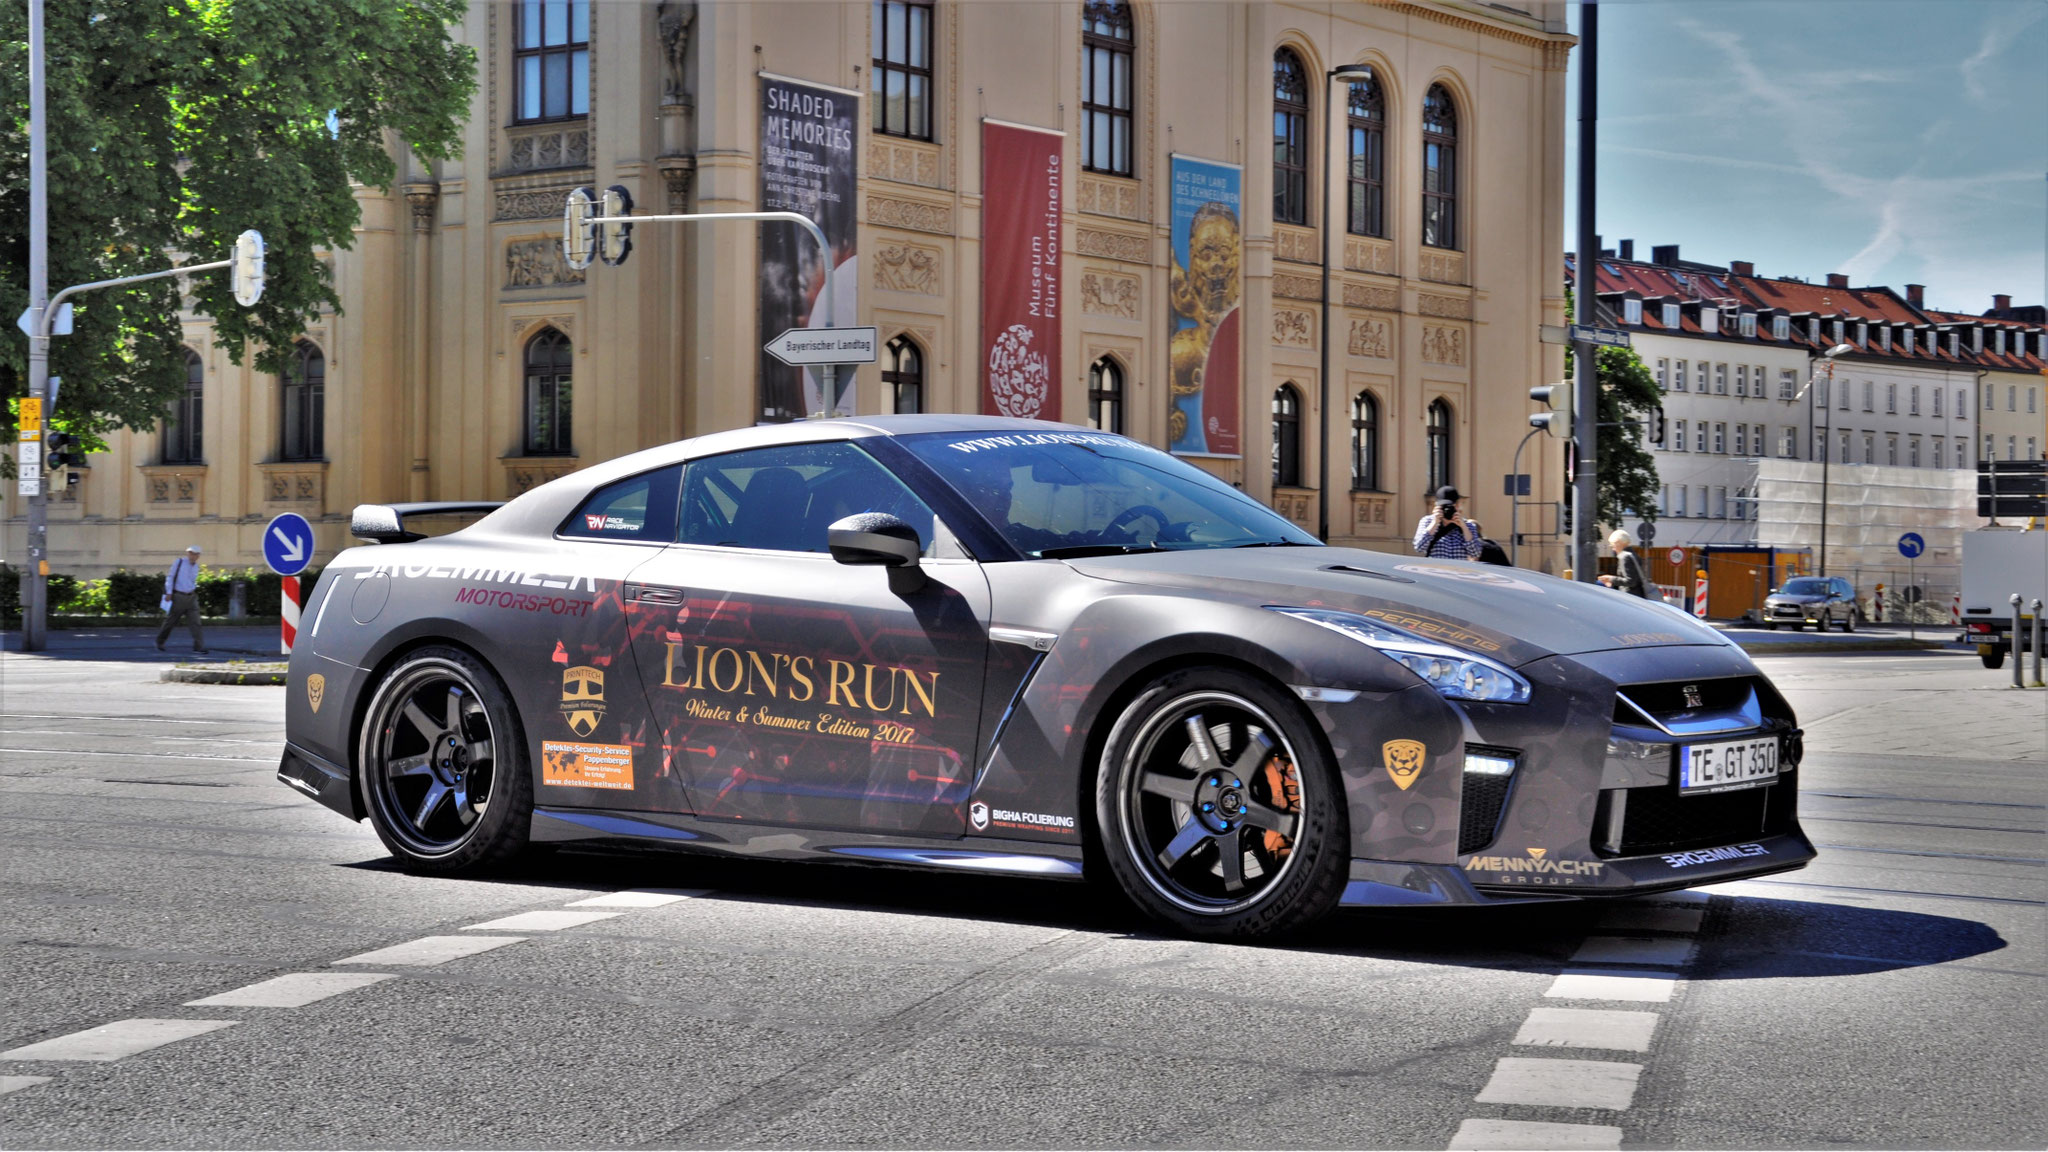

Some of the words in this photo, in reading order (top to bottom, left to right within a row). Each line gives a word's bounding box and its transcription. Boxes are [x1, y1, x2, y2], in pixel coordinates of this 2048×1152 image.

[768, 87, 834, 119] SHADED
[767, 116, 852, 150] MEMORIES
[1045, 154, 1059, 266] Kontinente
[1029, 236, 1041, 317] Museum
[1044, 273, 1056, 318] Fünf
[786, 340, 835, 353] Bayerischer
[837, 339, 871, 352] Landtag
[455, 587, 594, 618] MOTORSPORT
[1364, 609, 1502, 652] PERSHING
[566, 669, 601, 680] PRINTTECH
[661, 642, 814, 701] LION'S
[826, 659, 941, 718] RUN
[686, 698, 731, 722] Winter
[736, 706, 749, 723] &
[753, 705, 812, 731] Summer
[816, 713, 870, 739] Edition
[873, 723, 915, 743] 2017
[583, 754, 630, 767] Pappenberger
[1692, 748, 1713, 782] TE
[1725, 745, 1745, 779] GT
[1749, 742, 1776, 776] 350
[992, 809, 1021, 822] BIGHA
[1022, 812, 1074, 827] FOLIERUNG
[1465, 856, 1605, 876] MENNYACHT
[1661, 844, 1770, 869] BROEMMLER
[1502, 876, 1574, 885] GROUP
